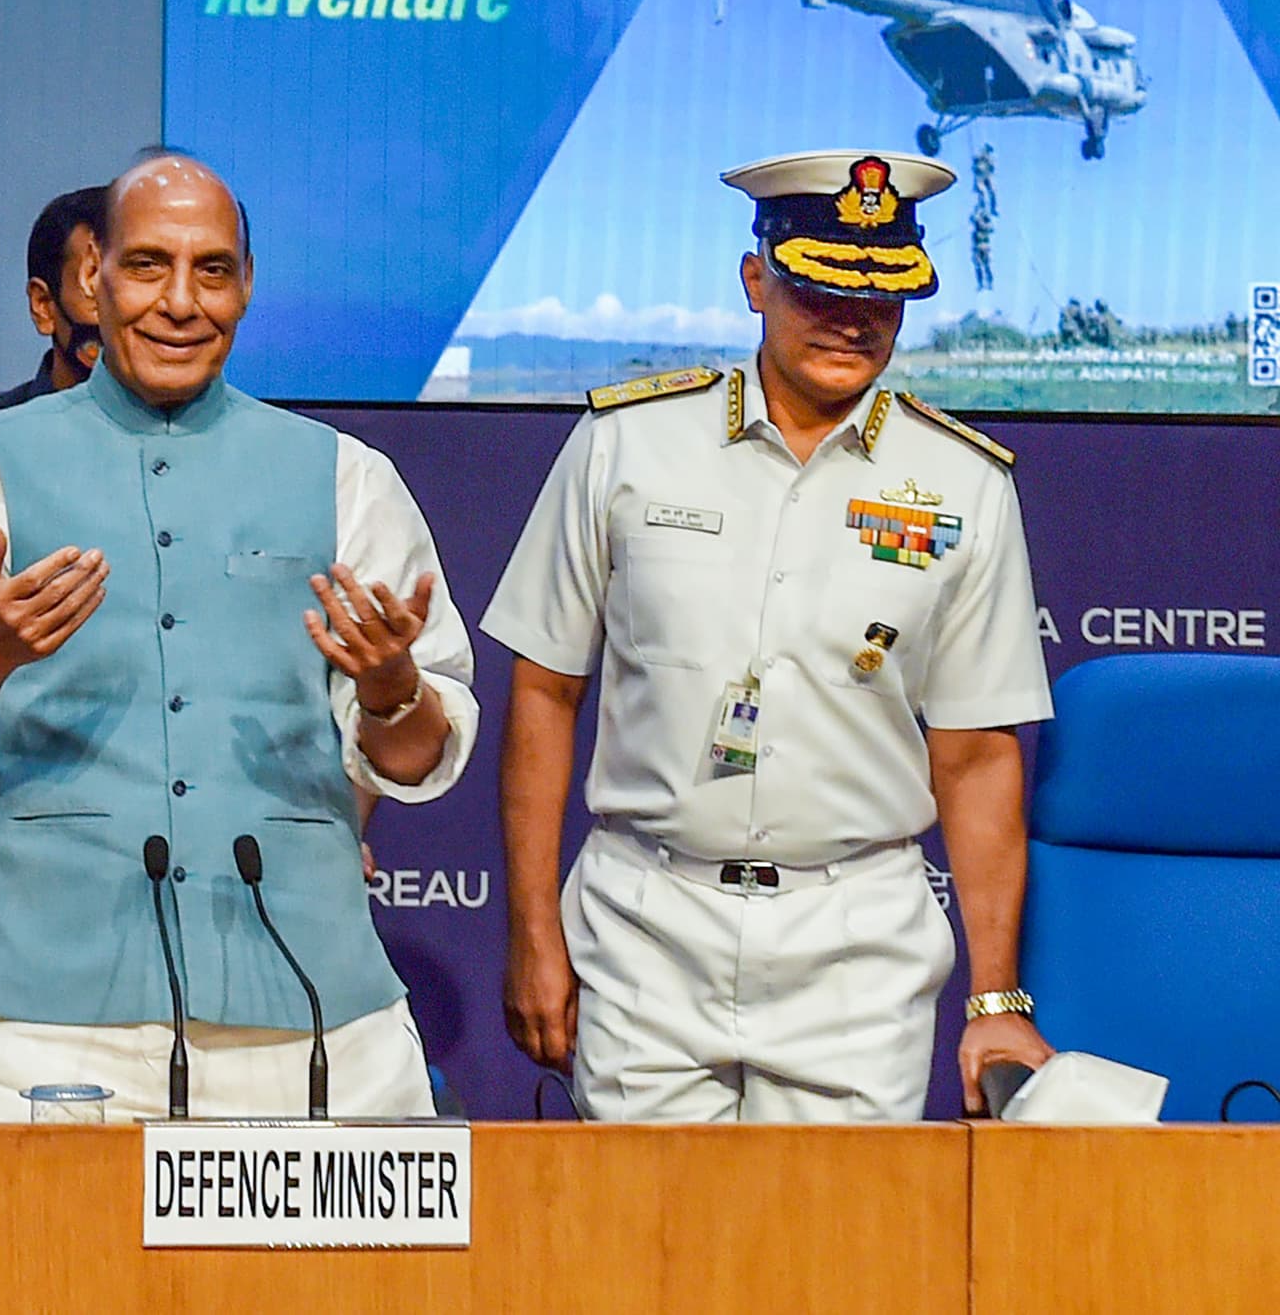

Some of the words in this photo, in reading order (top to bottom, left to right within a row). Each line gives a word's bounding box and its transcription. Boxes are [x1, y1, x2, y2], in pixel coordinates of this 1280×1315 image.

[1081, 607, 1265, 647] CENTRE
[365, 870, 489, 908] REAU
[154, 1149, 302, 1218] DEFENCE
[312, 1150, 459, 1218] MINISTER
